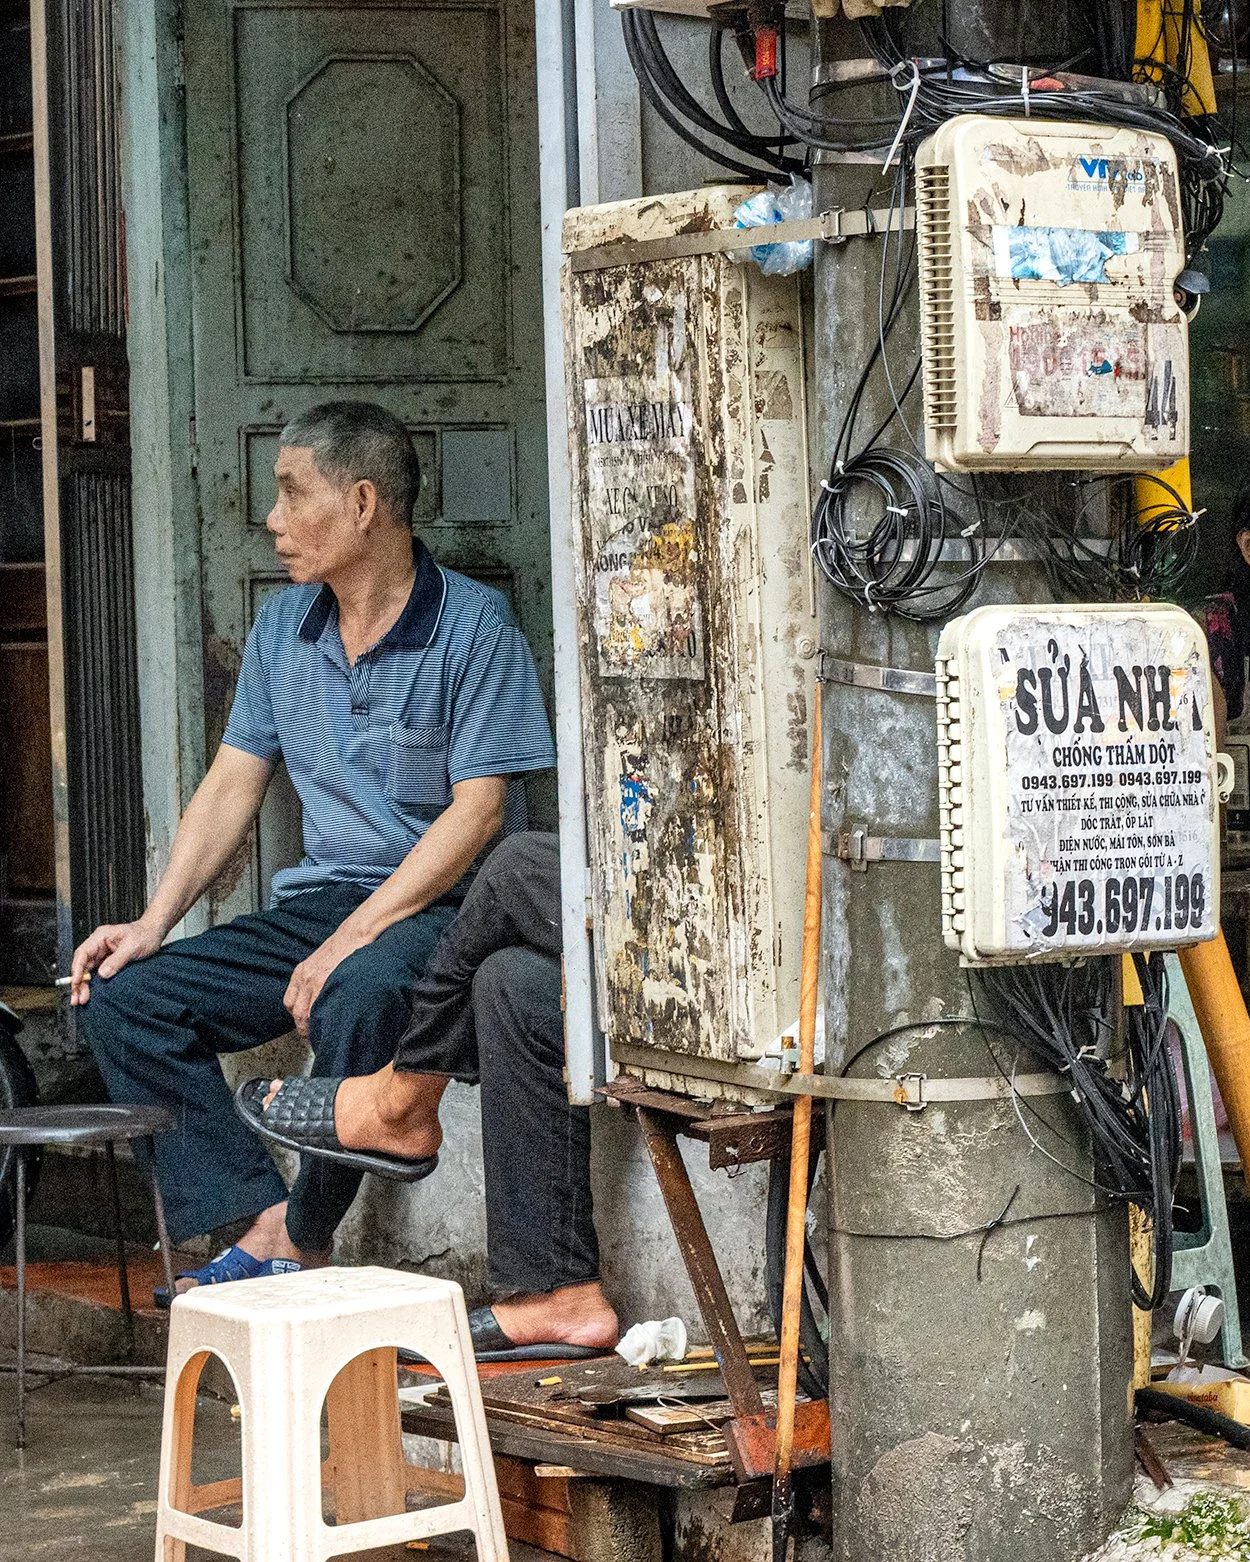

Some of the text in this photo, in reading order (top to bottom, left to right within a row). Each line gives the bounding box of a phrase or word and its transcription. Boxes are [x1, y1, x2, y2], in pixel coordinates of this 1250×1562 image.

[1016, 638, 1203, 735] SỬA NH
[1053, 735, 1176, 769] CHỐNG THẤM DỘT
[1021, 770, 1201, 790] 0943.697.199 0943.697.199
[1021, 798, 1034, 812] TƯ
[1035, 794, 1054, 812] VẤN
[1056, 793, 1081, 811] THIẾT
[1083, 792, 1097, 811] KẾ,
[1100, 796, 1113, 809] THI
[1115, 793, 1140, 810] CÔNG,
[1142, 790, 1157, 808] SỬA
[1159, 791, 1181, 807] CHỮA
[1182, 790, 1199, 806] NHÀ
[1081, 814, 1098, 830] DÓC
[1125, 811, 1136, 829] ỐP
[1138, 812, 1153, 828] LÁT
[1059, 835, 1081, 854] ĐIỆN
[1083, 834, 1108, 851] NƯỚC,
[1109, 834, 1125, 849] MÁI
[1126, 833, 1145, 850] TÔN,
[1147, 833, 1163, 848] SƠN
[1073, 858, 1088, 871] THI
[1089, 855, 1112, 870] CÔNG
[1114, 856, 1136, 872] TRỌN
[1138, 852, 1152, 868] GÓI
[1154, 851, 1166, 867] TỪ
[1167, 855, 1173, 867] A
[1178, 854, 1184, 867] Z
